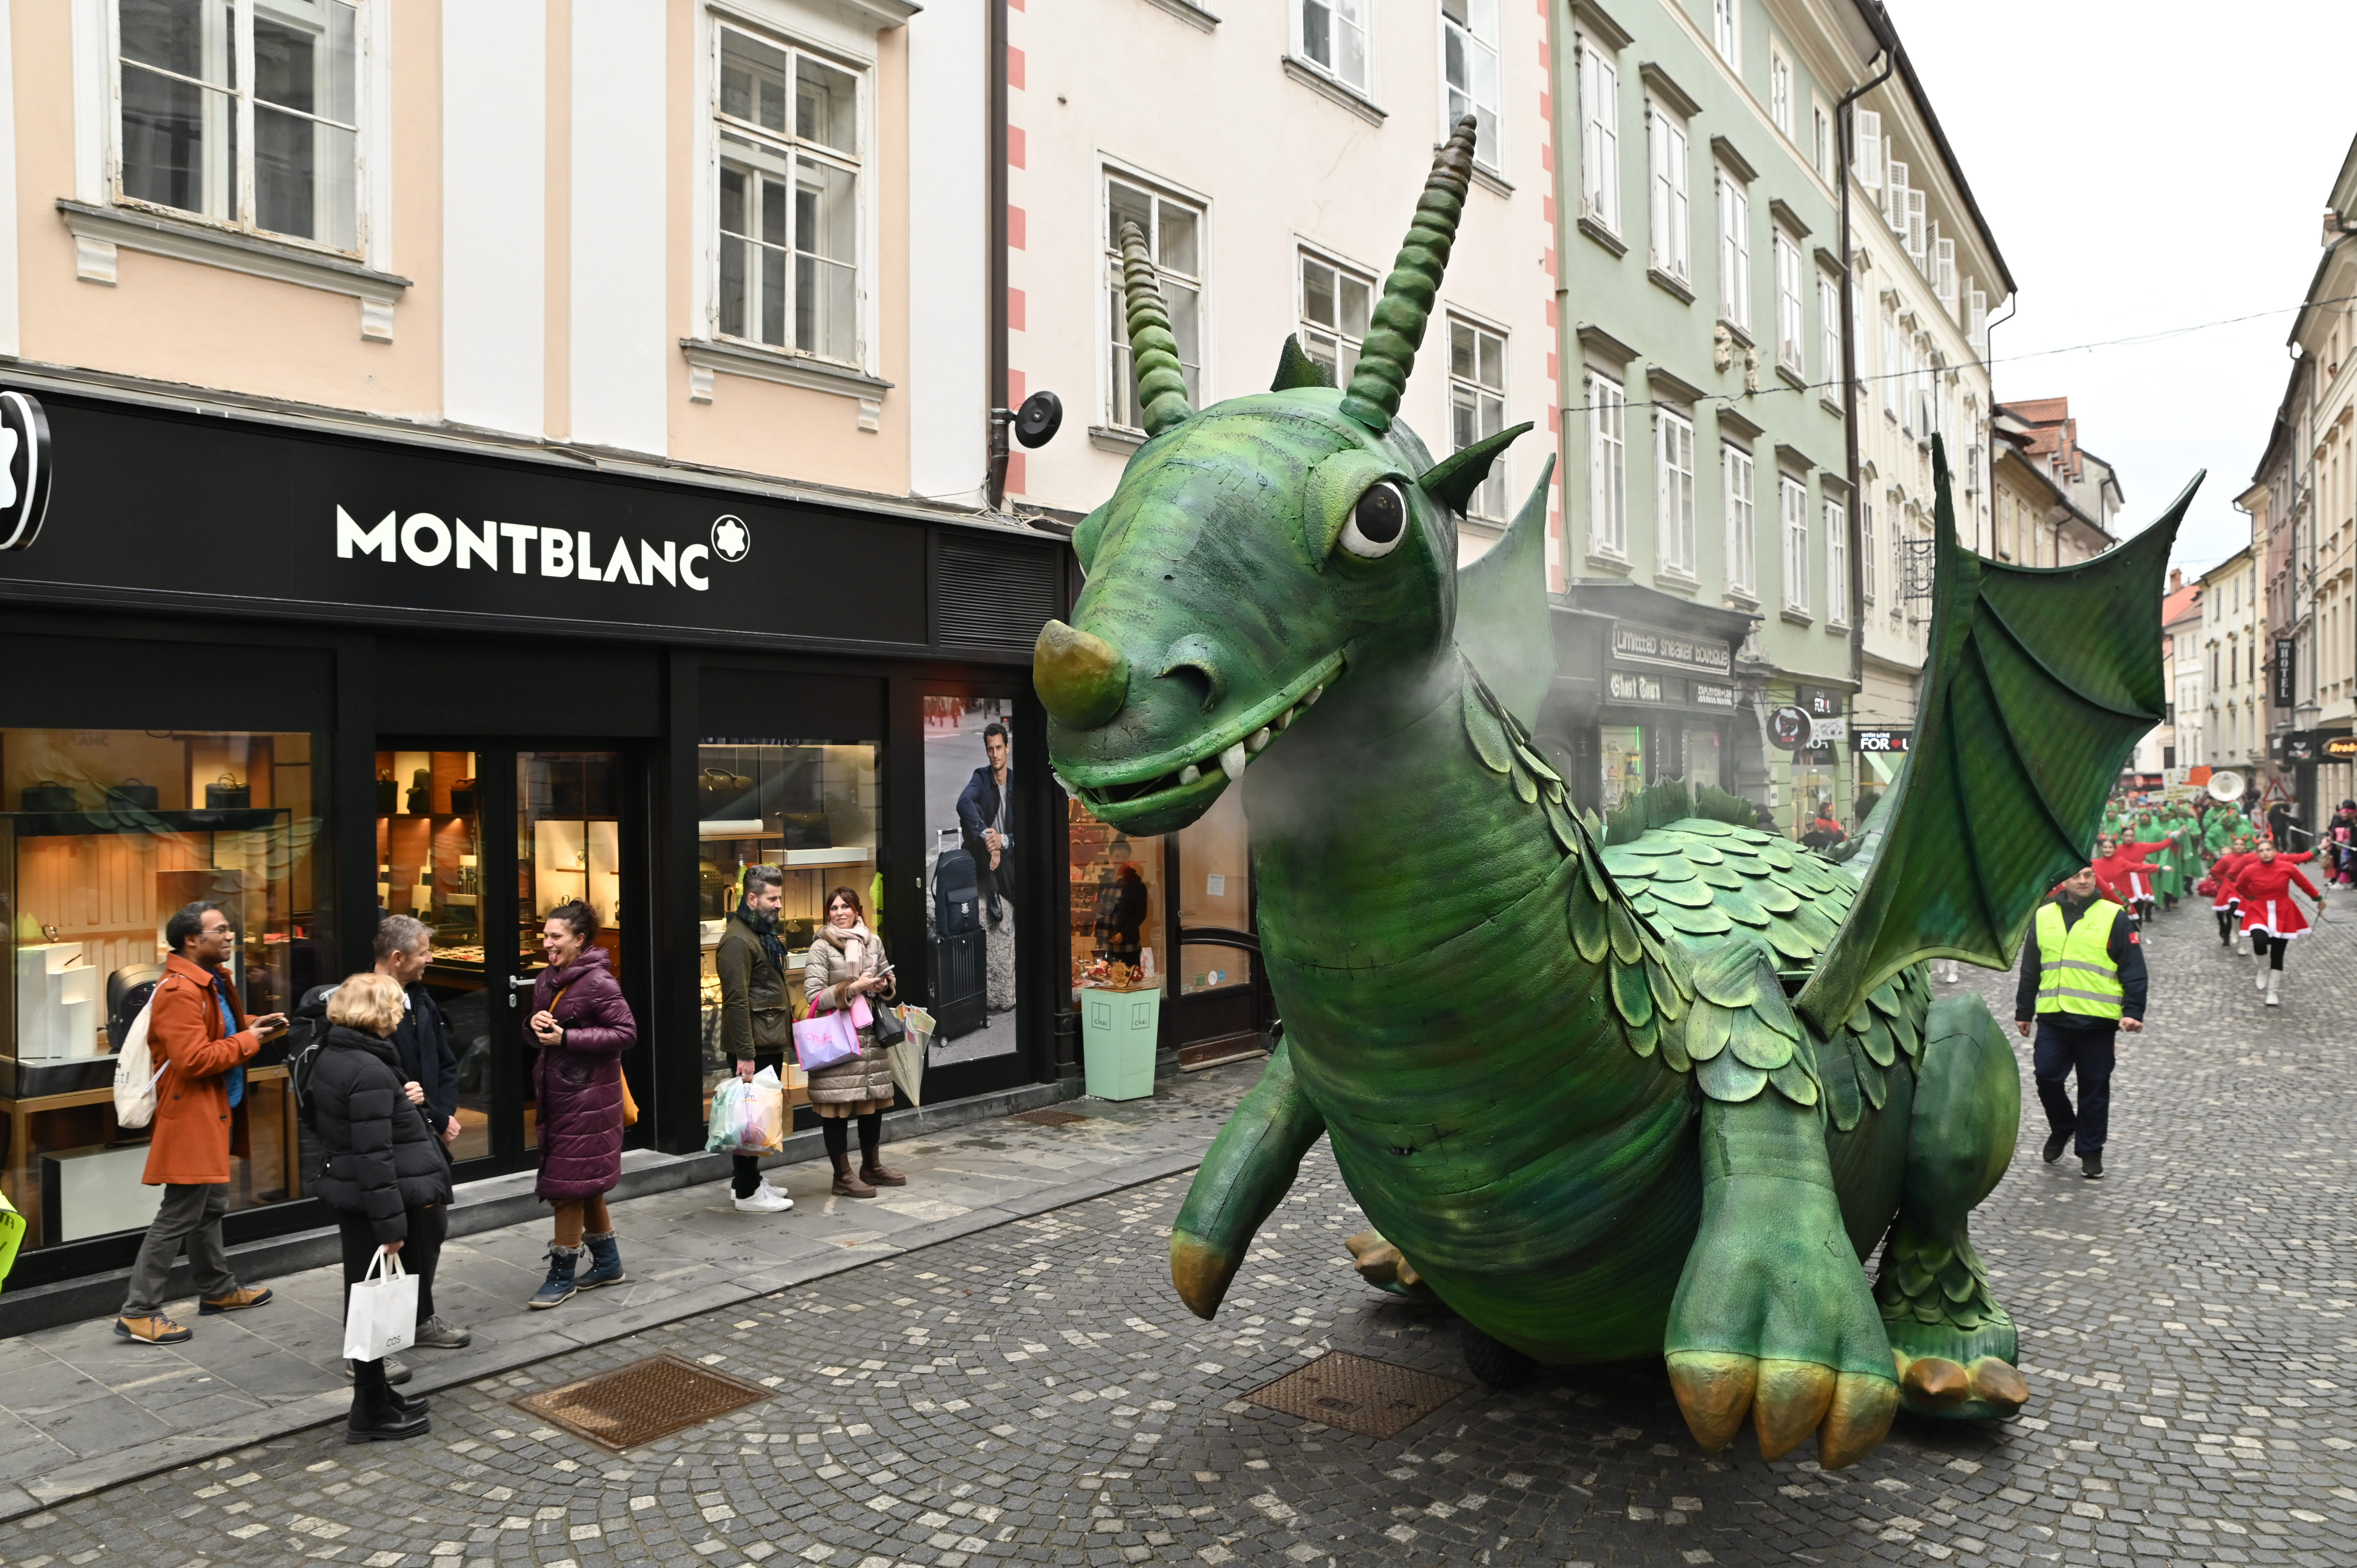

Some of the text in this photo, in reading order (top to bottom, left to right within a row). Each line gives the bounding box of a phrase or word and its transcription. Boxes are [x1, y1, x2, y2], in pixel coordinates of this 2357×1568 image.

[336, 504, 710, 591] MONTBLANC
[2280, 648, 2289, 697] HOTEL
[1861, 738, 1890, 750] FOR
[386, 1335, 401, 1347] COS
